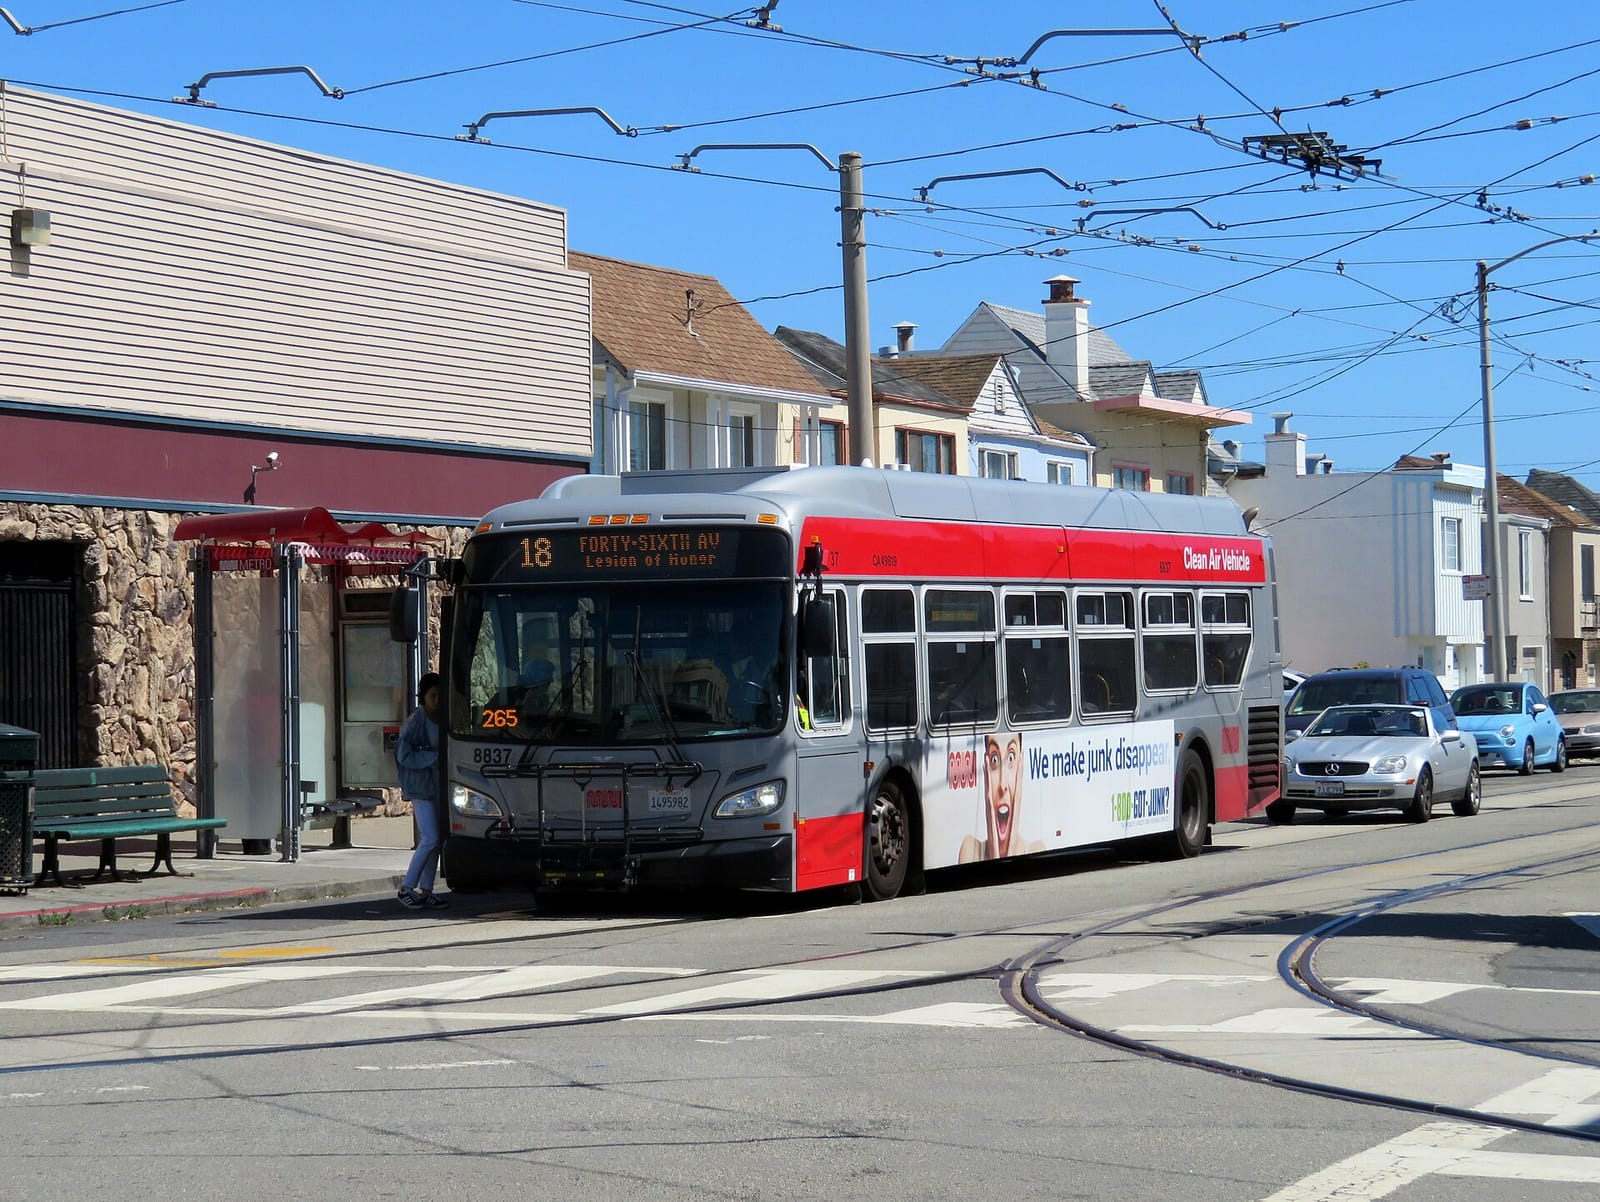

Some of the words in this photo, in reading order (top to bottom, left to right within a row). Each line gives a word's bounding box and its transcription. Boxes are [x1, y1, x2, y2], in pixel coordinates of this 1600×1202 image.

[579, 534, 690, 552] FORTY-SIXTH
[698, 532, 721, 550] AV
[520, 537, 552, 568] 18
[586, 555, 637, 569] Legion
[645, 555, 661, 567] of
[670, 553, 716, 567] Honor
[1183, 545, 1207, 571] Clean
[1208, 547, 1222, 572] Air
[1222, 547, 1250, 573] Vehicle
[239, 558, 272, 571] METRO
[482, 708, 518, 728] 265
[473, 747, 512, 765] 8837
[1029, 747, 1050, 780] We
[1052, 742, 1086, 777] make
[1086, 740, 1113, 783] junk
[651, 796, 689, 809] 1495982
